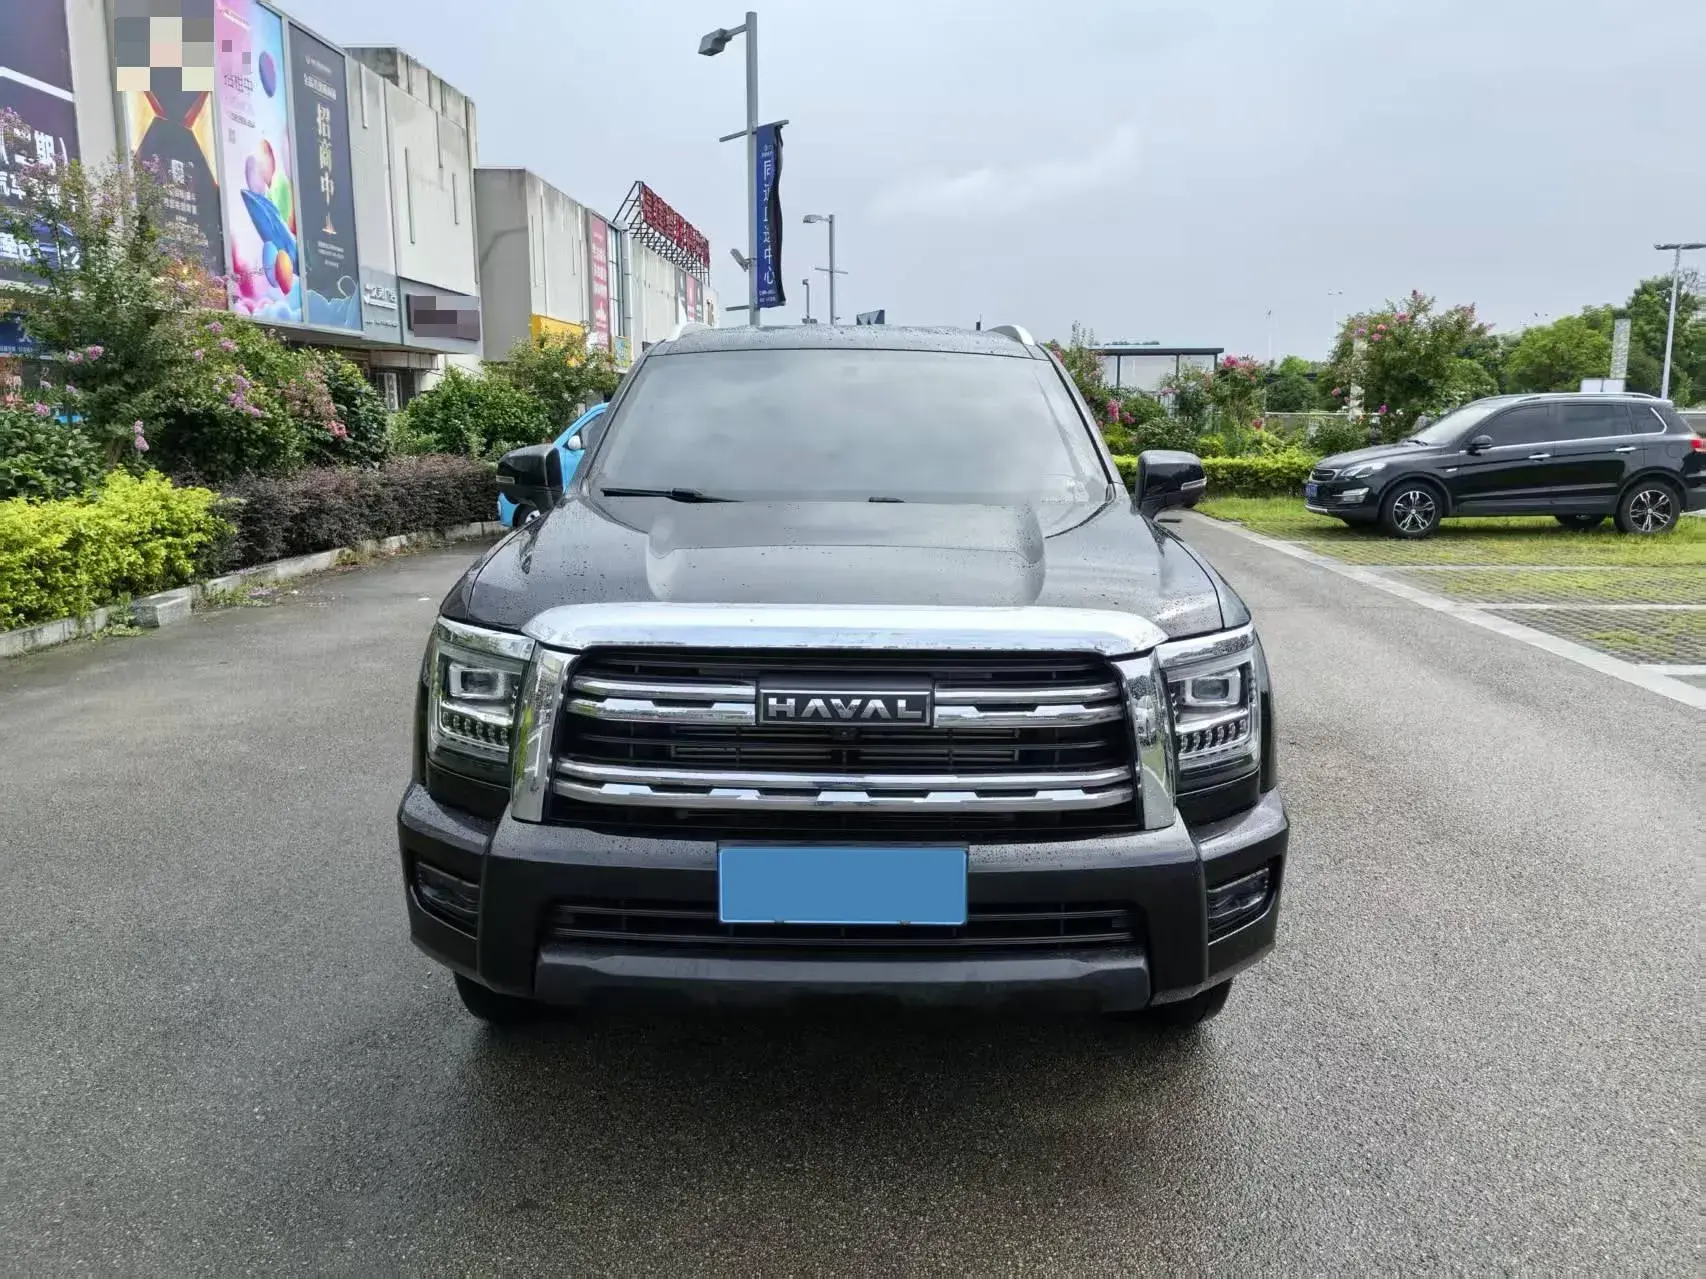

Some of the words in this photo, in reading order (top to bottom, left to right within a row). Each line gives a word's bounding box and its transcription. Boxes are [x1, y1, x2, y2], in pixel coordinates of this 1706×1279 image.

[316, 103, 334, 206] 招商中
[768, 697, 922, 720] HAVAL
